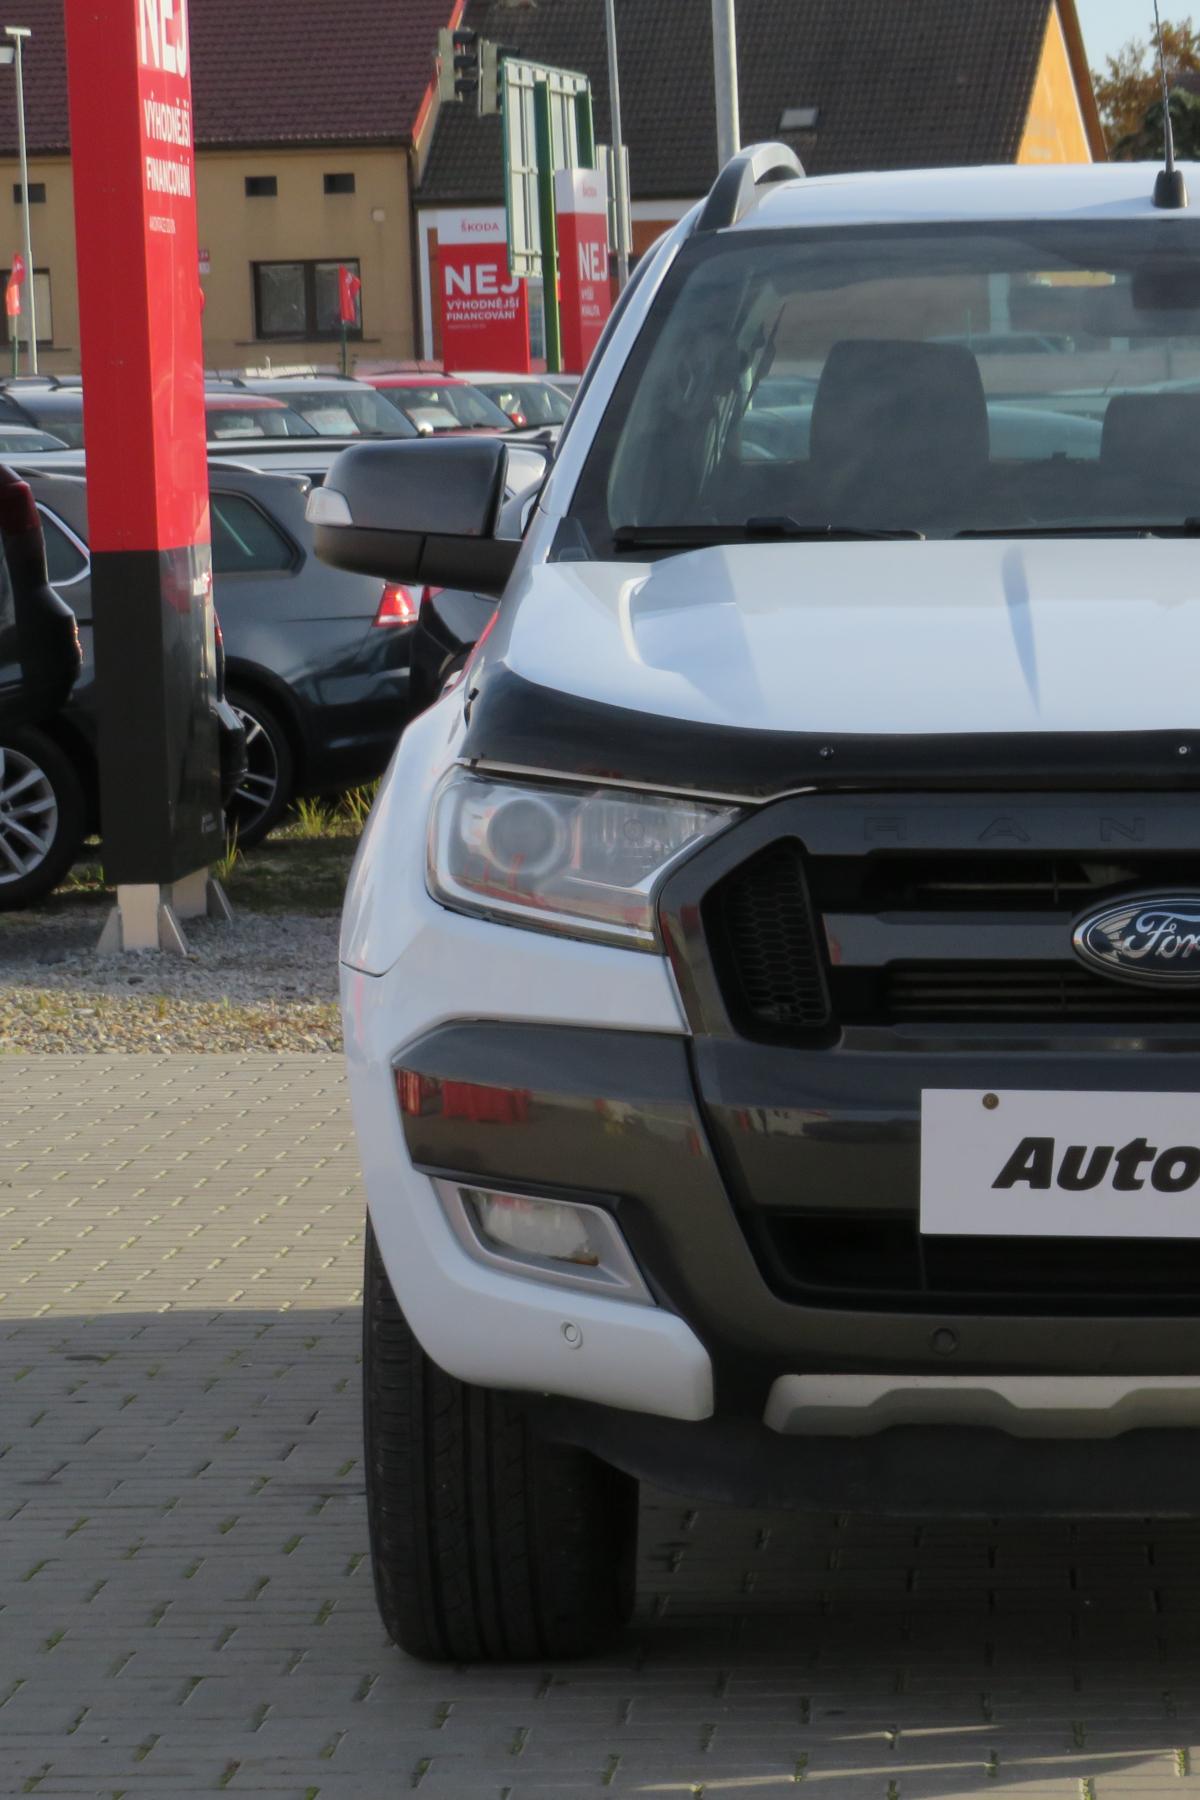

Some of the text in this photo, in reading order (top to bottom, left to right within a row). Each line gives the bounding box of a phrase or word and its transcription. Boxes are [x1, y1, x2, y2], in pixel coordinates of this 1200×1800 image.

[139, 0, 187, 79] NEJ
[143, 90, 191, 148] VÝHODNĚJŠÍ
[145, 154, 191, 198] FINANCOVÁNÍ
[461, 219, 500, 233] ŠKODA
[444, 263, 520, 296] NEJ
[578, 241, 608, 282] NEJ
[446, 309, 516, 321] FINANCOVÁNÍ
[447, 296, 520, 311] VÝHODNĚJŠÍ
